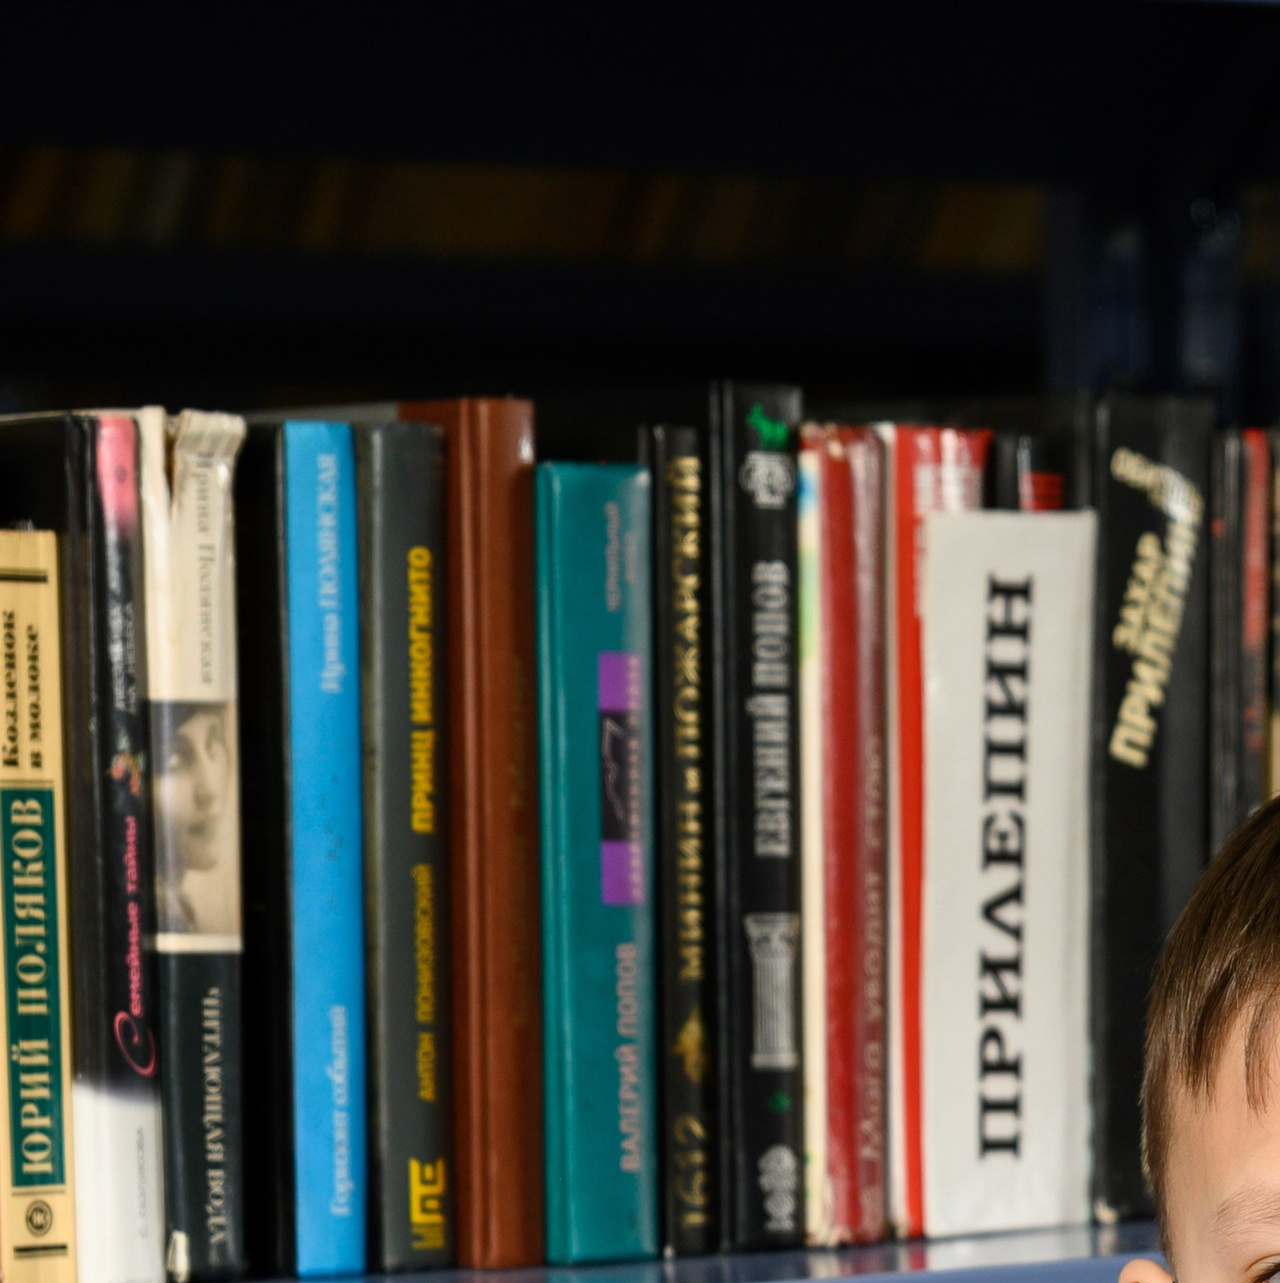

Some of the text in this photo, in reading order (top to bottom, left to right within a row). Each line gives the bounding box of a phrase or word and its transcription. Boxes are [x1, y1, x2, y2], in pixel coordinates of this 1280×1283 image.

[316, 453, 347, 693] Ирина ПОЛЯНСКАЯ
[407, 545, 436, 834] ПРИНЦ ИНКОГНИТО
[666, 455, 701, 759] ПОЖАРСКИЙ
[751, 560, 790, 688] ПОПОВ
[1112, 532, 1165, 650] ЗАХАР
[25, 624, 43, 770] в молоке
[744, 693, 791, 858] ЕВГЕНИЙ
[8, 797, 54, 1176] ЮРИЙ ПОЛЯКОВ
[114, 814, 157, 1077] Семейные тайны
[411, 861, 437, 1102] АНТОН ПОНИЗОВСКИЙ
[676, 800, 705, 980] МИНИН
[978, 572, 1033, 1161] ПРИЛЕПИН
[202, 986, 228, 1244] ЧИТАЮЩАЯ ВОДА
[613, 940, 642, 1172] ВАЛЕРИЙ ПОПОВ
